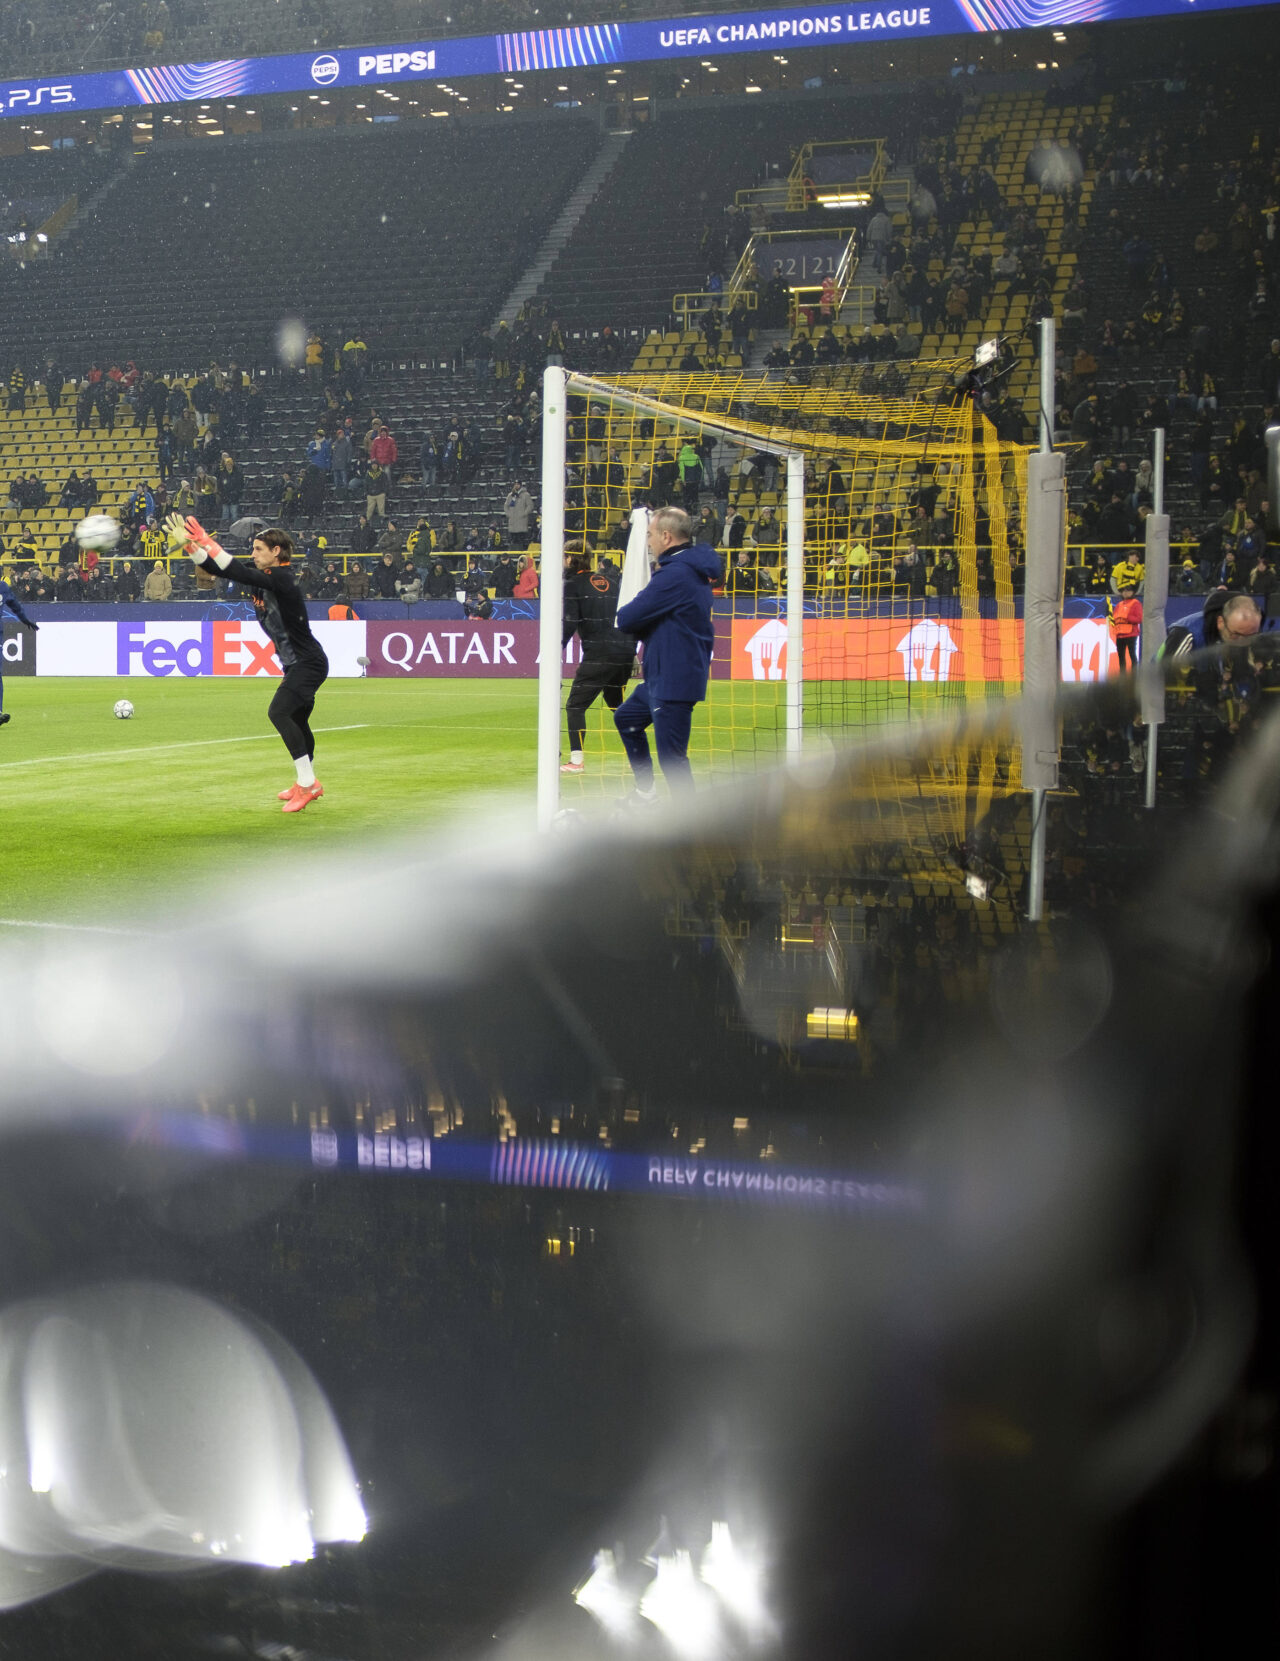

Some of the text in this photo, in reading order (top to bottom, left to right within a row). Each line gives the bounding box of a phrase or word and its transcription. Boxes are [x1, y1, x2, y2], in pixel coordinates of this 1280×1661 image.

[660, 8, 931, 47] UEFA CHAMPIONS LEAGUE
[313, 66, 337, 74] PEPSI
[358, 50, 436, 76] PEPSI
[8, 85, 74, 108] PS5
[117, 621, 285, 676] FedEx
[381, 631, 517, 672] QATAR
